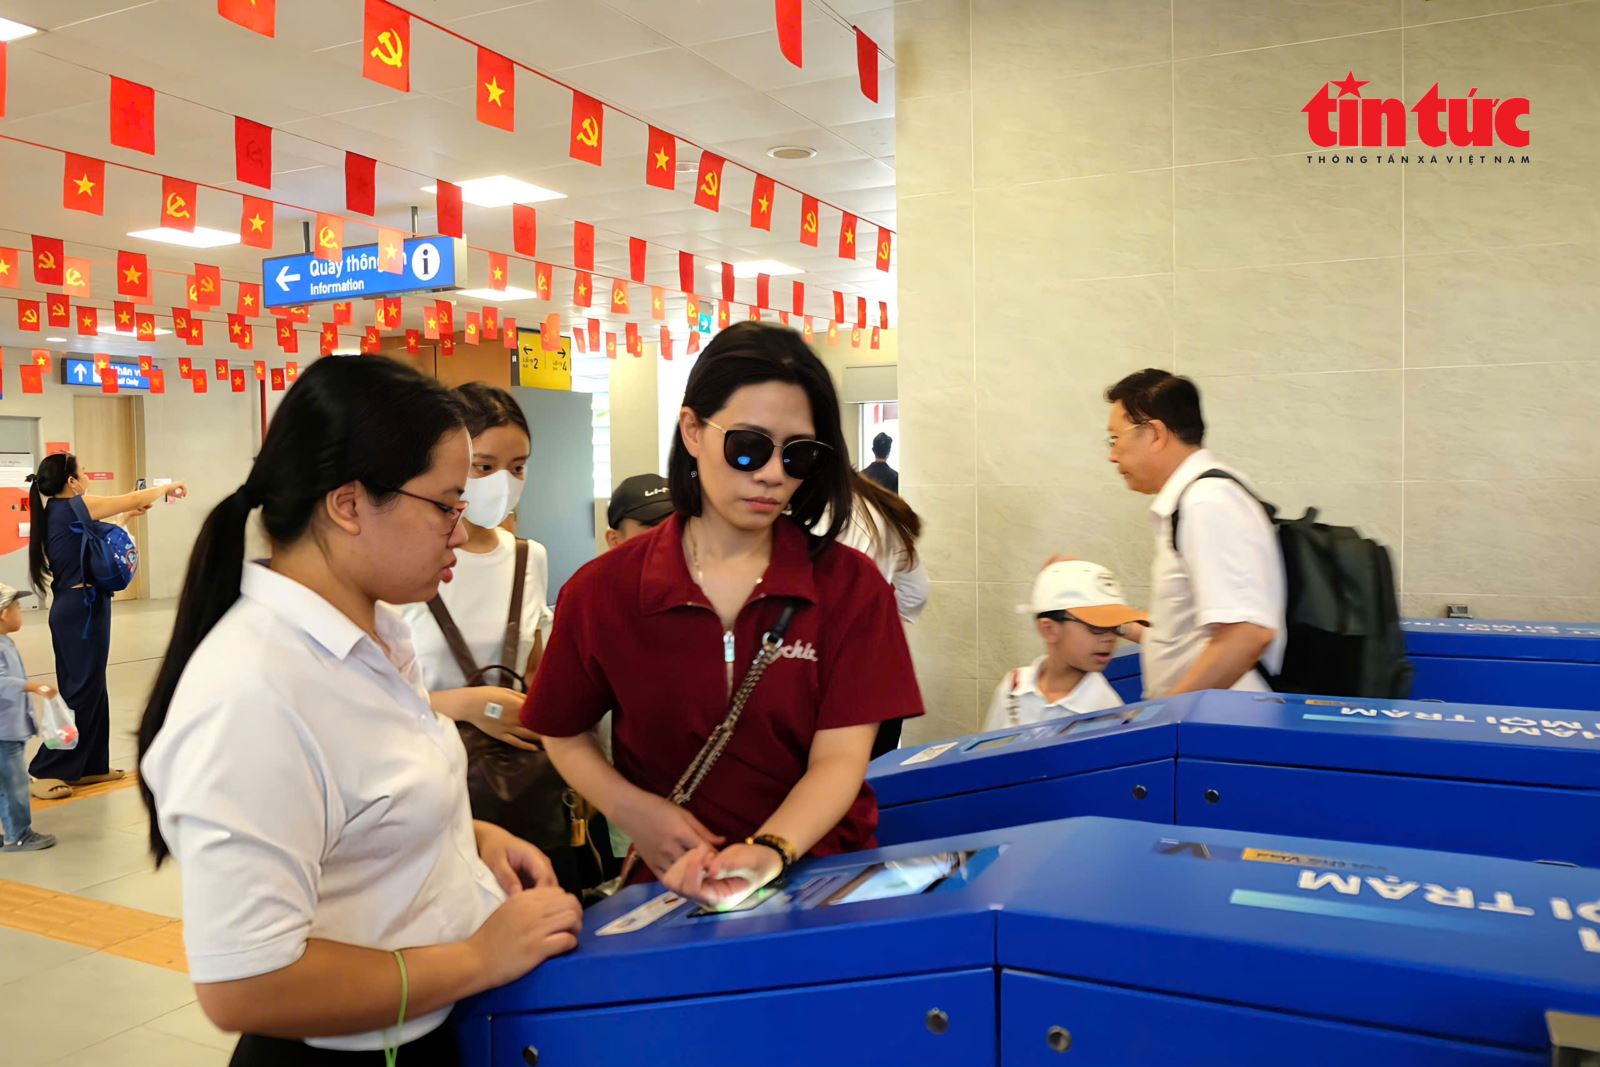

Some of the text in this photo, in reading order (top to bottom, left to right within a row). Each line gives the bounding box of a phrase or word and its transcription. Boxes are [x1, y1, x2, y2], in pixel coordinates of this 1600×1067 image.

[310, 278, 365, 296] Information
[533, 358, 539, 370] 2
[1341, 706, 1476, 723] TRẠM
[1297, 869, 1536, 917] TRẠM
